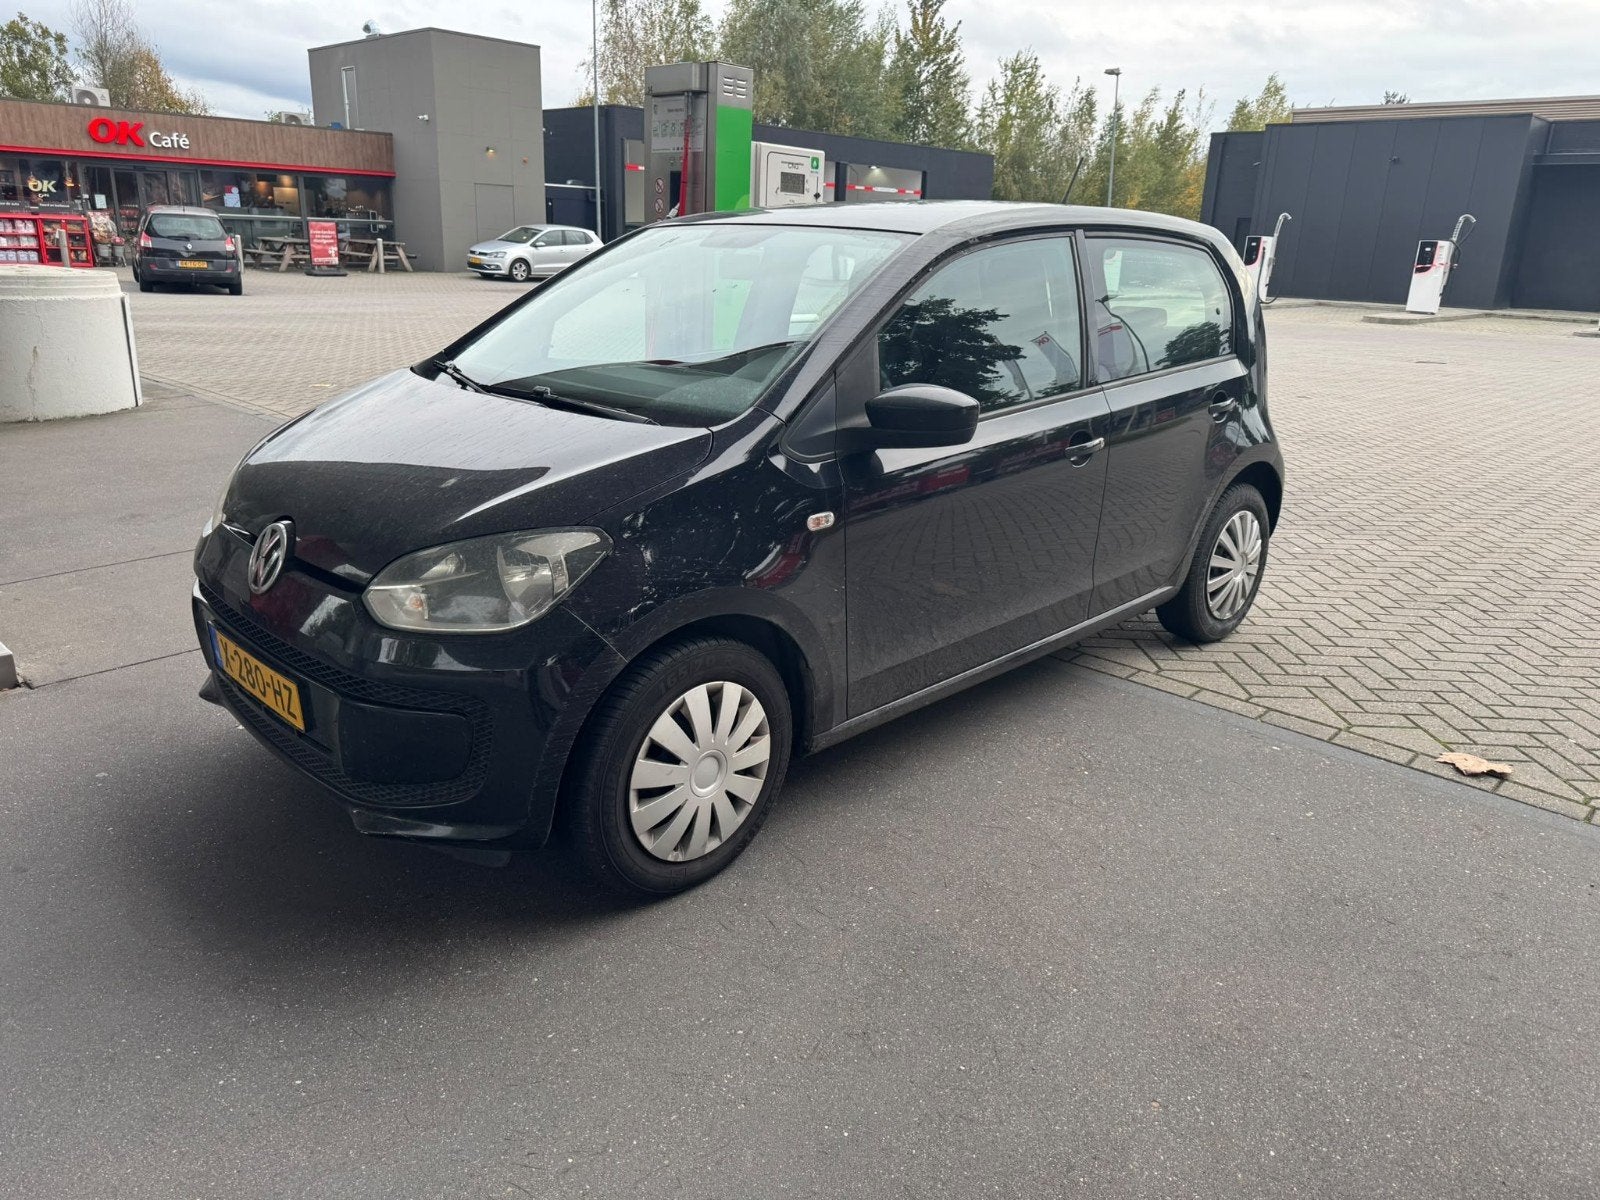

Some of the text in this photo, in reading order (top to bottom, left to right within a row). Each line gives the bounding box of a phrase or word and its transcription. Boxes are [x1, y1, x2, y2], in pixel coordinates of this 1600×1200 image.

[88, 117, 190, 149] OK Café
[28, 179, 57, 192] OK
[219, 639, 298, 721] X-280-HZ
